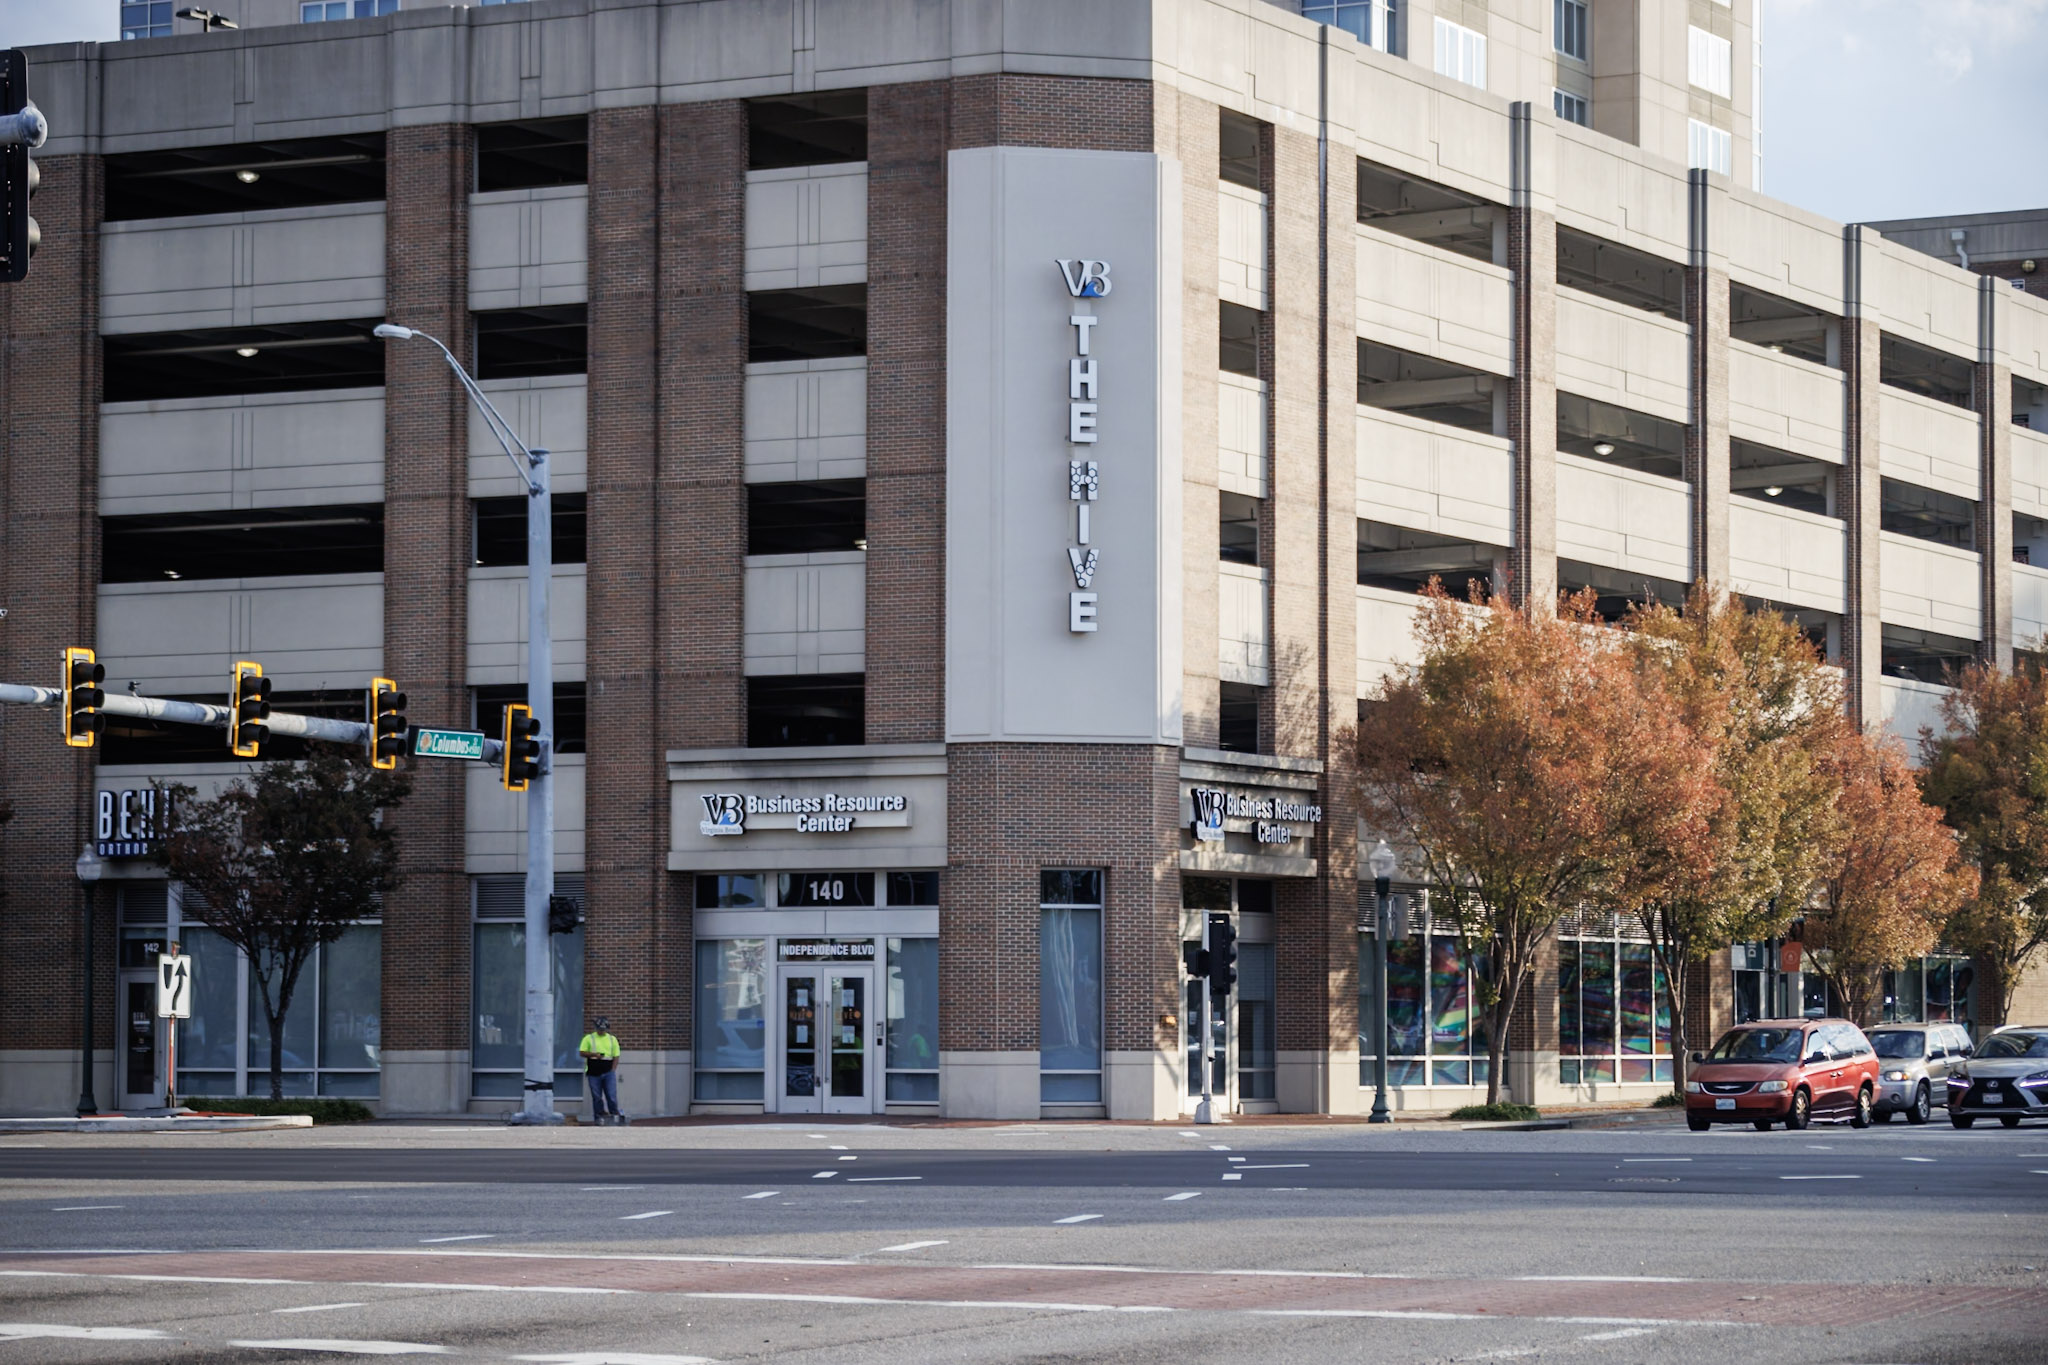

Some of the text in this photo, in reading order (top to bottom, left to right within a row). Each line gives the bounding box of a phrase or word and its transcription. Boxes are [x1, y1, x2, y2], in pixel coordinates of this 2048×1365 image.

[1055, 259, 1112, 298] VB
[1068, 315, 1098, 444] THE
[1067, 460, 1100, 632] HIVE
[432, 733, 470, 754] Columbus
[701, 793, 904, 826] VB Business Resource
[1226, 793, 1274, 819] Business
[1274, 798, 1321, 823] Resource
[796, 813, 853, 833] Center
[1257, 820, 1291, 844] Center
[809, 880, 844, 901] 140
[143, 942, 160, 953] 142
[780, 944, 875, 956] INDEPENDENCE BLVD
